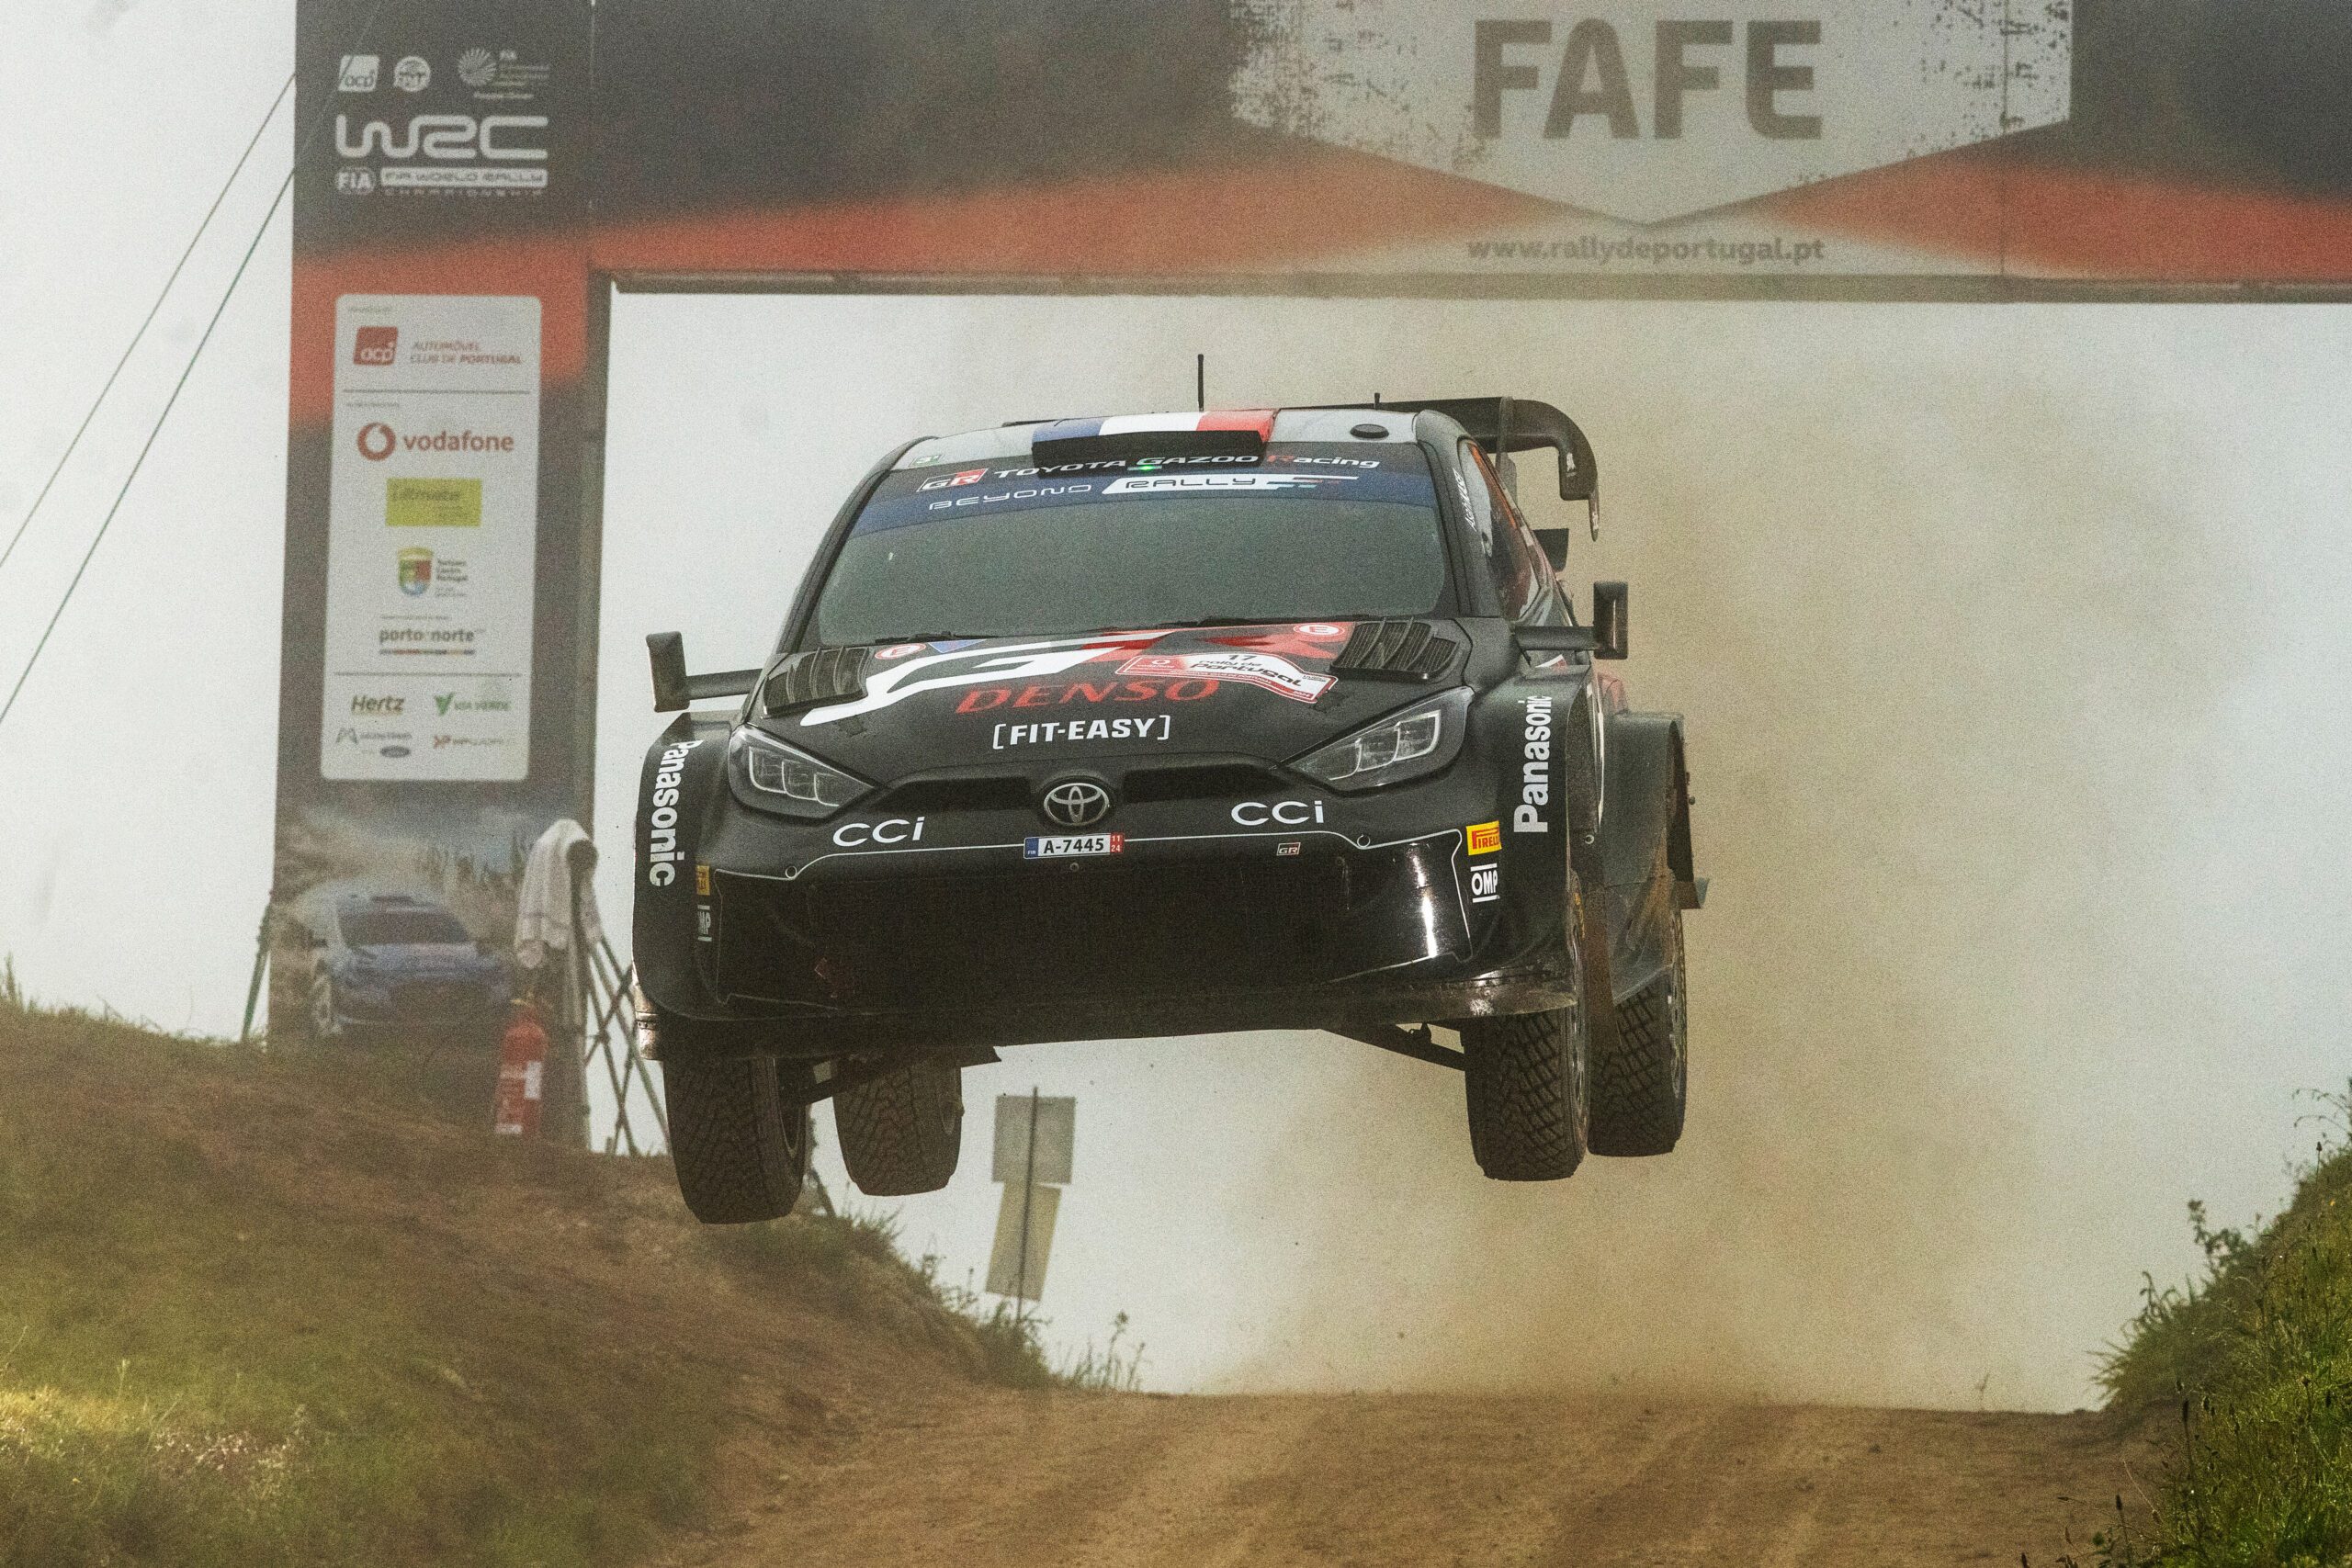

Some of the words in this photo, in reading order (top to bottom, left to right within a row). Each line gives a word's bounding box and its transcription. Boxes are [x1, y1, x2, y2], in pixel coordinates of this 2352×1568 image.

[1475, 17, 1823, 141] FAFE
[335, 114, 548, 160] WRC
[337, 170, 373, 191] FIA
[1467, 234, 1825, 266] www.rallydeportugal.pt
[402, 430, 514, 452] vodafone
[920, 471, 985, 491] GR
[993, 459, 1126, 479] TOYOTA
[1136, 456, 1260, 467] GAZOO
[1266, 455, 1381, 469] Racing
[928, 483, 1093, 511] BEYOND
[1125, 478, 1257, 490] RALLY
[379, 628, 424, 645] porto
[430, 628, 475, 642] norte
[351, 694, 405, 712] Hertz
[956, 678, 1220, 715] DENSO
[1513, 695, 1554, 833] Panasonic
[649, 739, 703, 887] Panasonic
[1043, 838, 1104, 854] A-7445
[1111, 844, 1122, 852] 24
[1112, 834, 1121, 842] 11
[1278, 845, 1299, 855] GR
[1471, 869, 1498, 896] OMP
